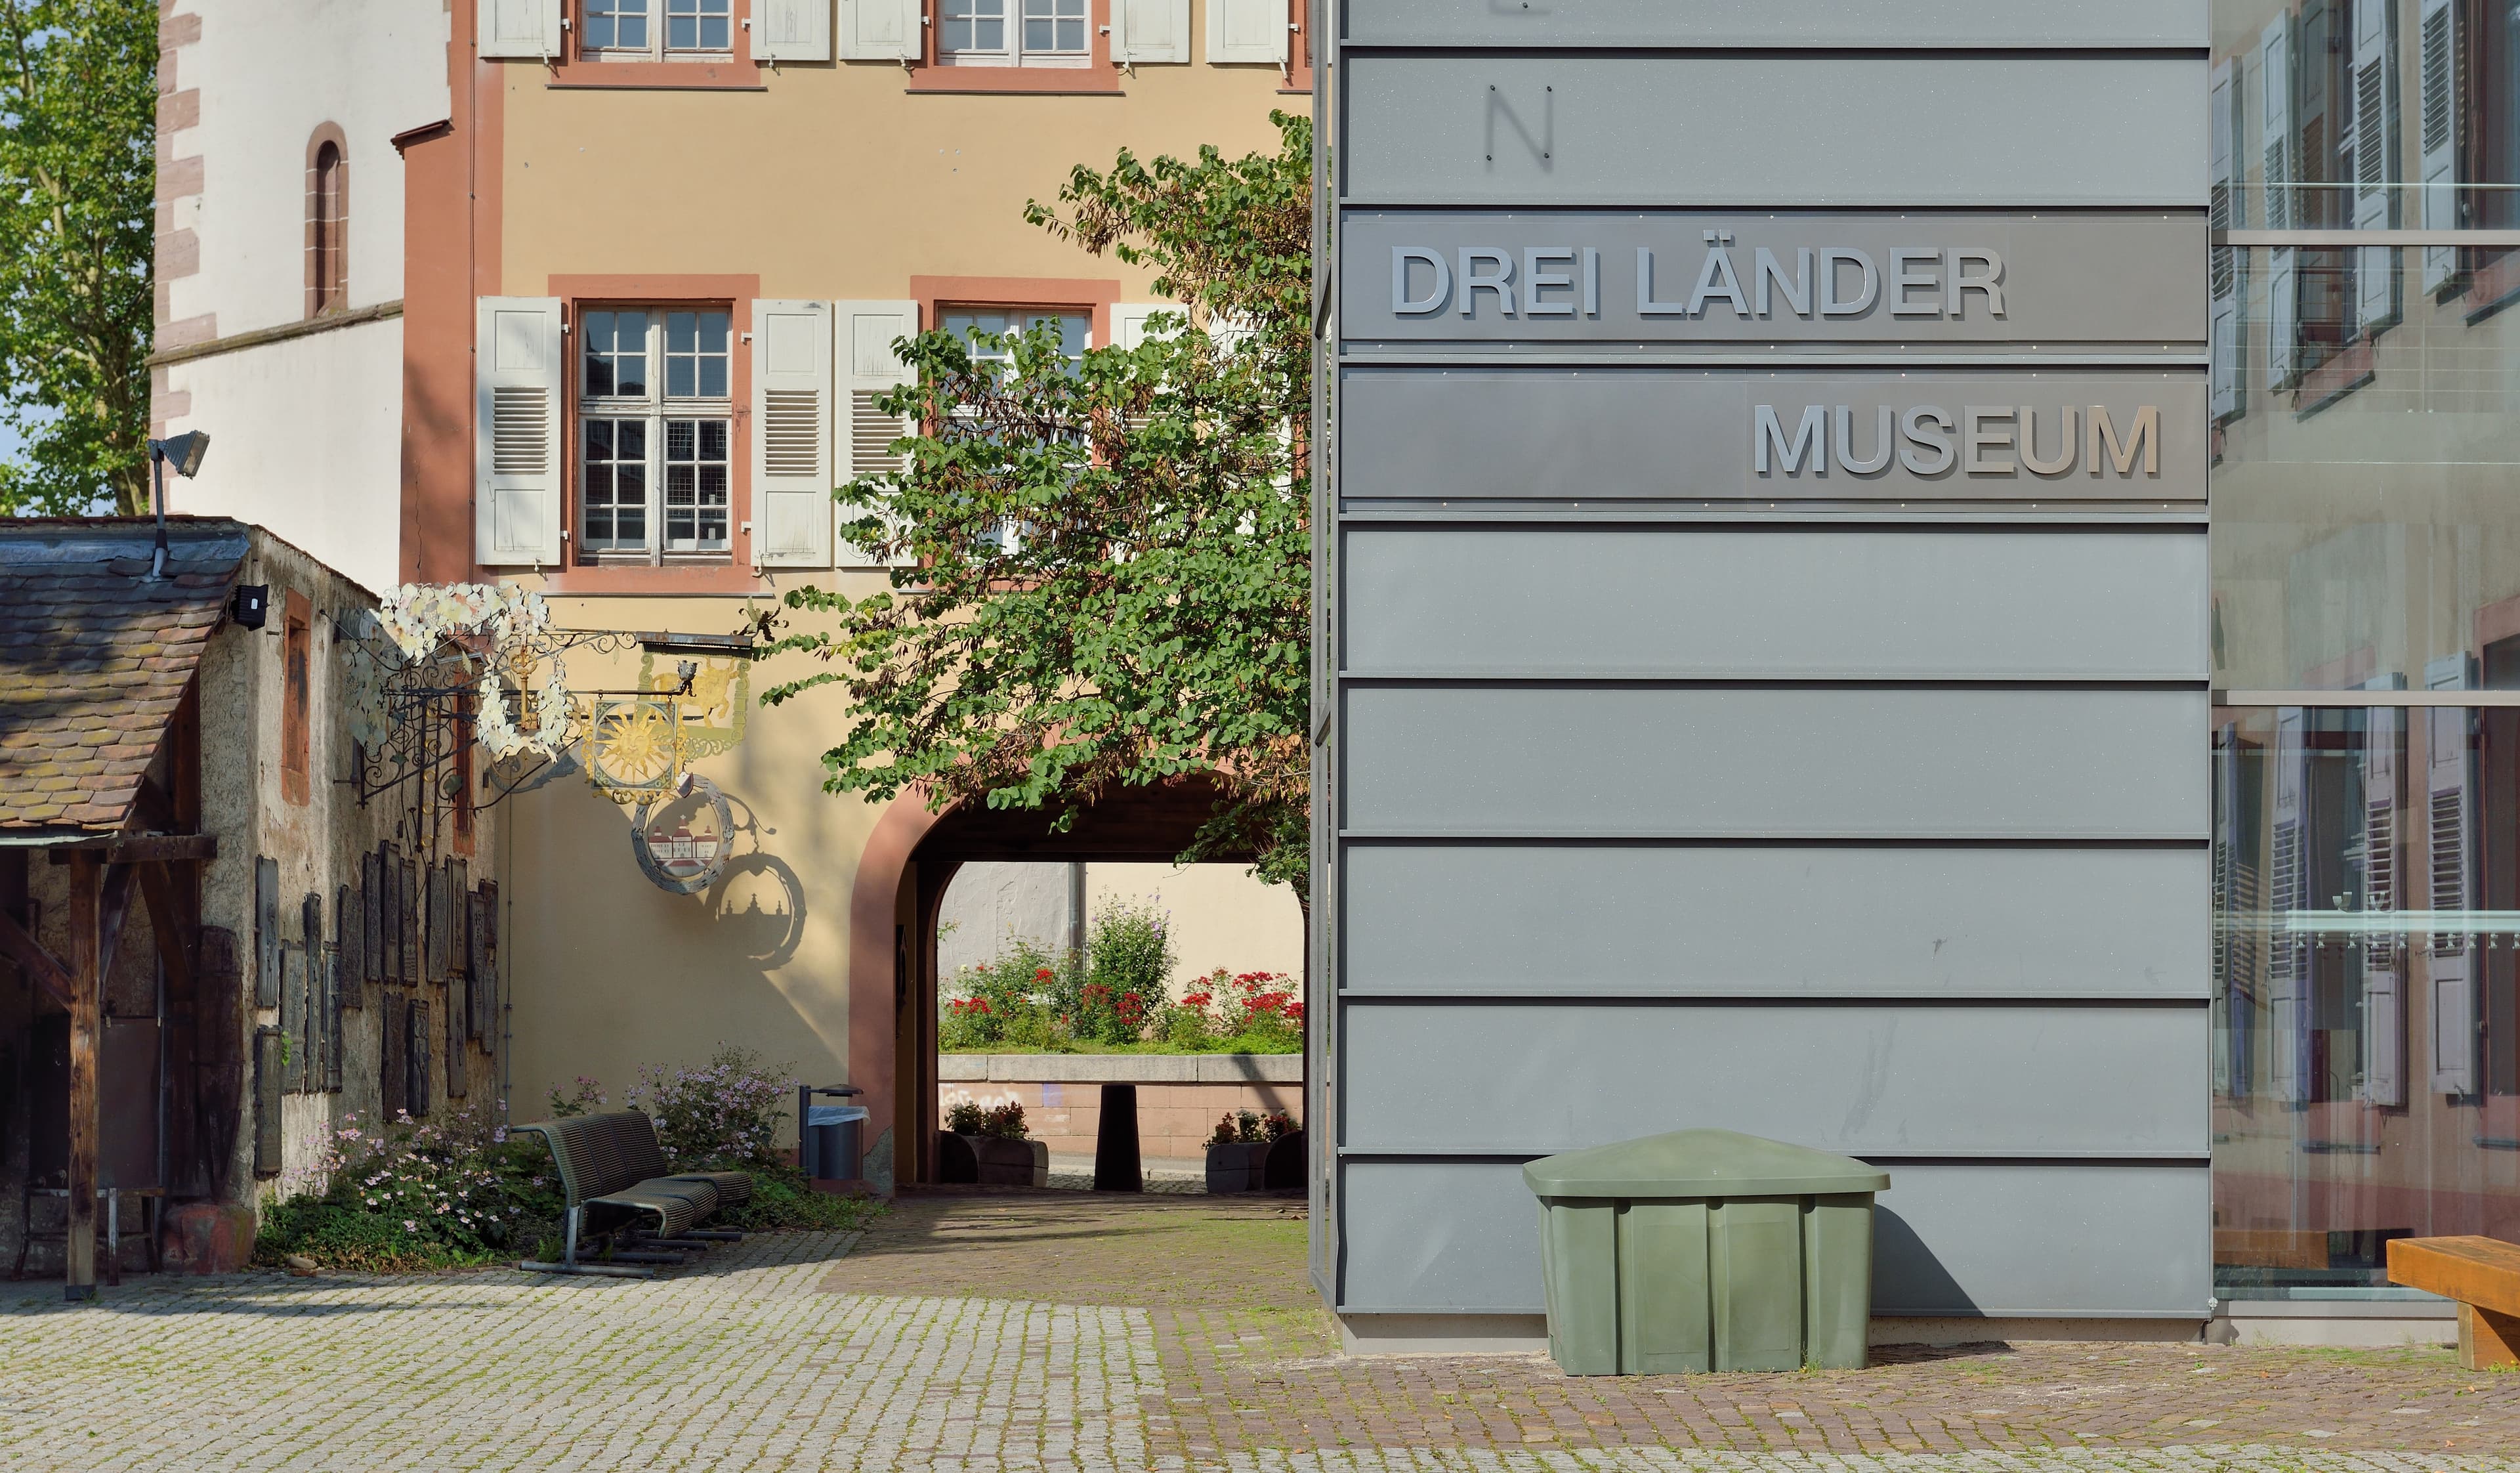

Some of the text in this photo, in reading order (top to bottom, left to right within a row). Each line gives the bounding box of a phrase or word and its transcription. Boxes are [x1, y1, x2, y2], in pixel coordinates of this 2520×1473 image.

[1391, 229, 2006, 316] DREI LÄNDER
[1753, 404, 2158, 476] MUSEUM
